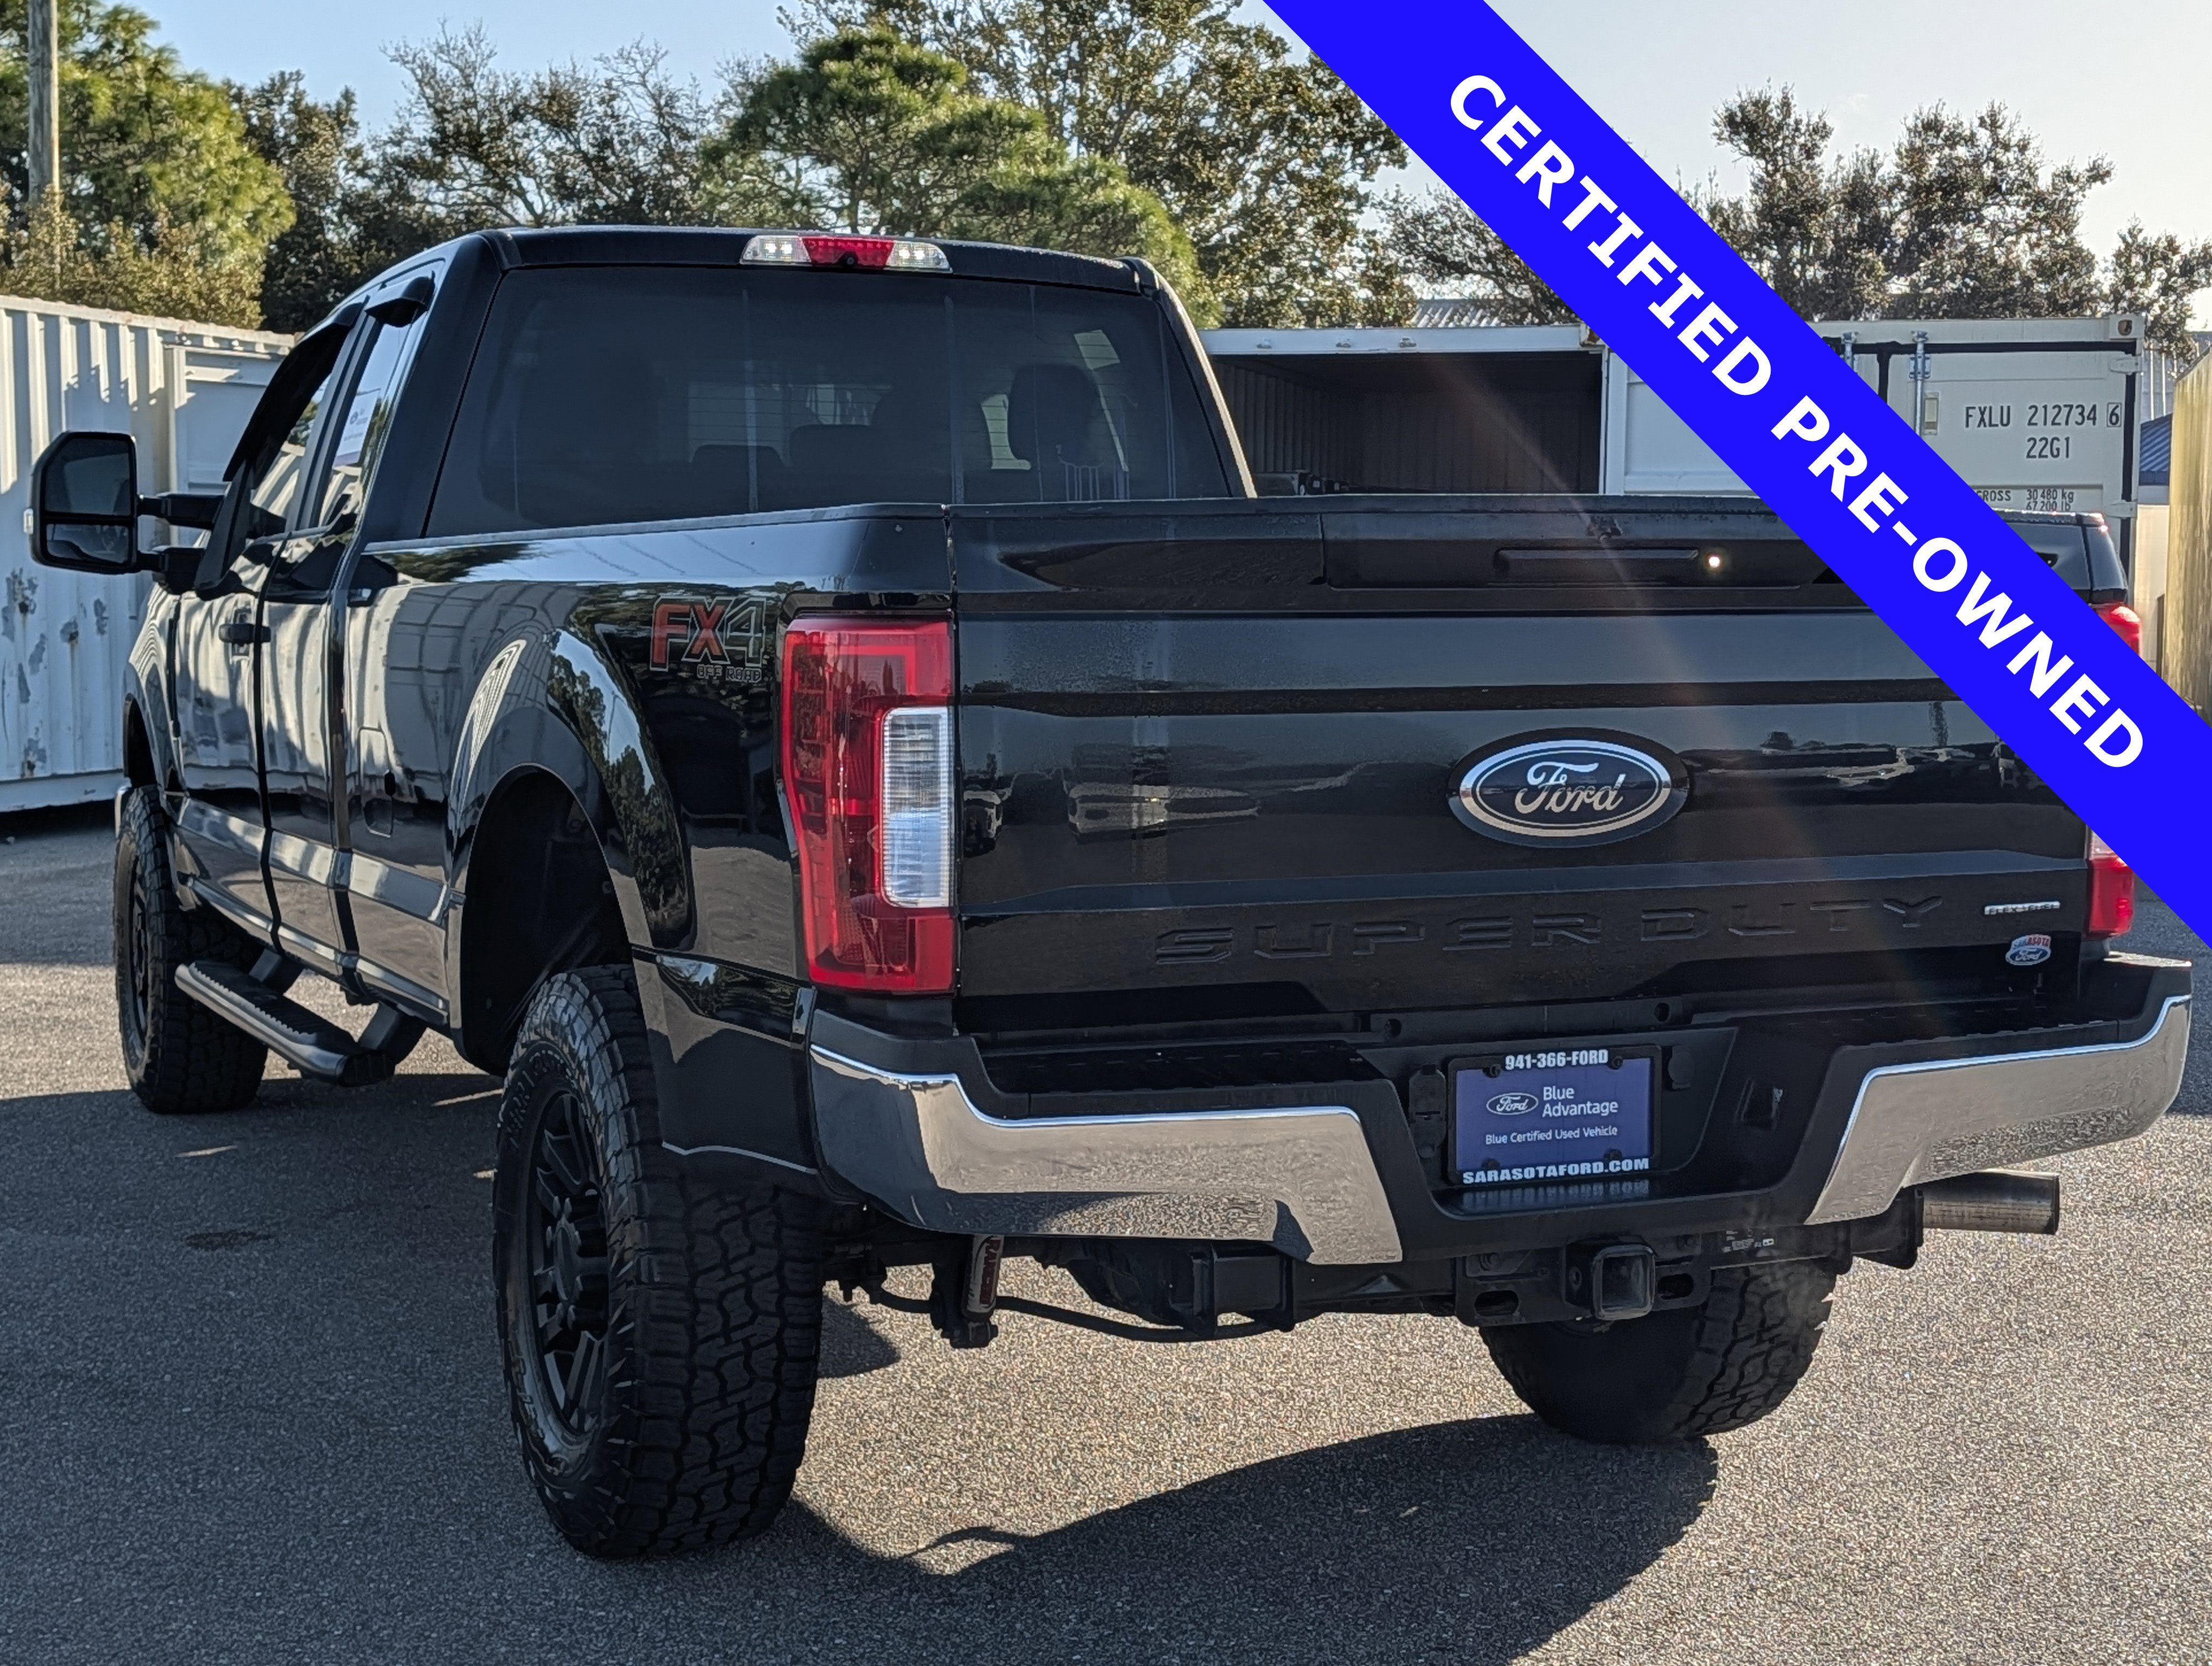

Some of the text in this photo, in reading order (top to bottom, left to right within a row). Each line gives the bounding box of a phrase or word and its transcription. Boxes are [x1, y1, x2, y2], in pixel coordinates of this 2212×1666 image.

[1965, 404, 2120, 427] FXLU 212734 6
[2025, 437, 2070, 459] 22G1
[2061, 489, 2074, 503] kg
[2061, 501, 2071, 511] lb
[650, 596, 767, 672] FX4
[1515, 761, 1626, 814] Ford
[1154, 895, 1943, 965] SUPER DUTY
[1505, 1048, 1609, 1071] 941-366-FORD
[1495, 1096, 1531, 1112] Ford
[1543, 1086, 1574, 1100] Blue
[1542, 1100, 1618, 1118] Advantage
[1486, 1125, 1618, 1145] Blue Certified Used Vehicle
[1463, 1157, 1650, 1184] SARASOTAFORD.COM
